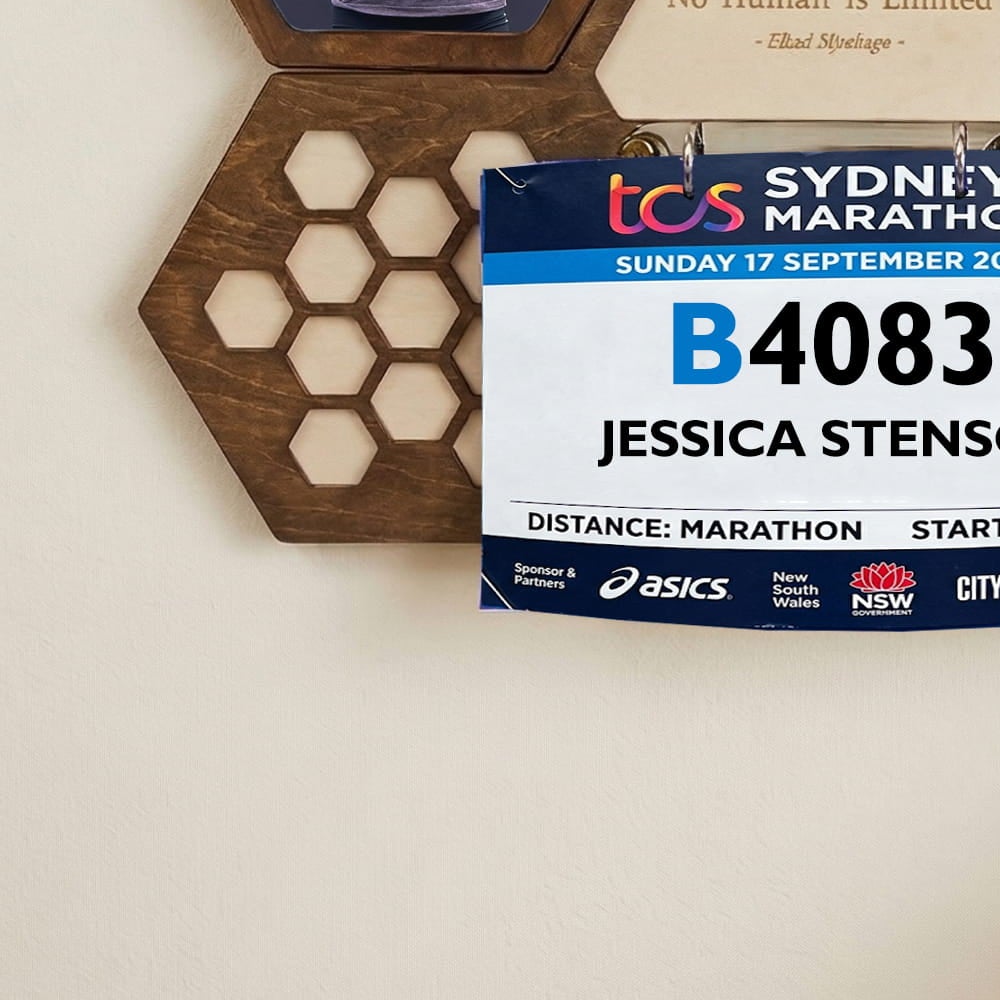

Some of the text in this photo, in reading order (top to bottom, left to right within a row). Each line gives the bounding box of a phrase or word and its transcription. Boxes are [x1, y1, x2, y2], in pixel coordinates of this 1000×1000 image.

[609, 173, 745, 235] tcs
[616, 253, 737, 274] SUNDAY
[743, 252, 773, 272] 17
[783, 251, 961, 272] SEPTEMBER
[672, 301, 993, 386] B4083
[597, 419, 806, 468] JESSICA
[528, 511, 862, 541] DISTANCE: MARATHON
[514, 562, 577, 579] Sponsor &
[772, 571, 808, 583] New
[514, 574, 565, 590] Partners
[772, 584, 819, 596] South
[772, 597, 820, 608] Wales
[852, 593, 914, 609] NSW
